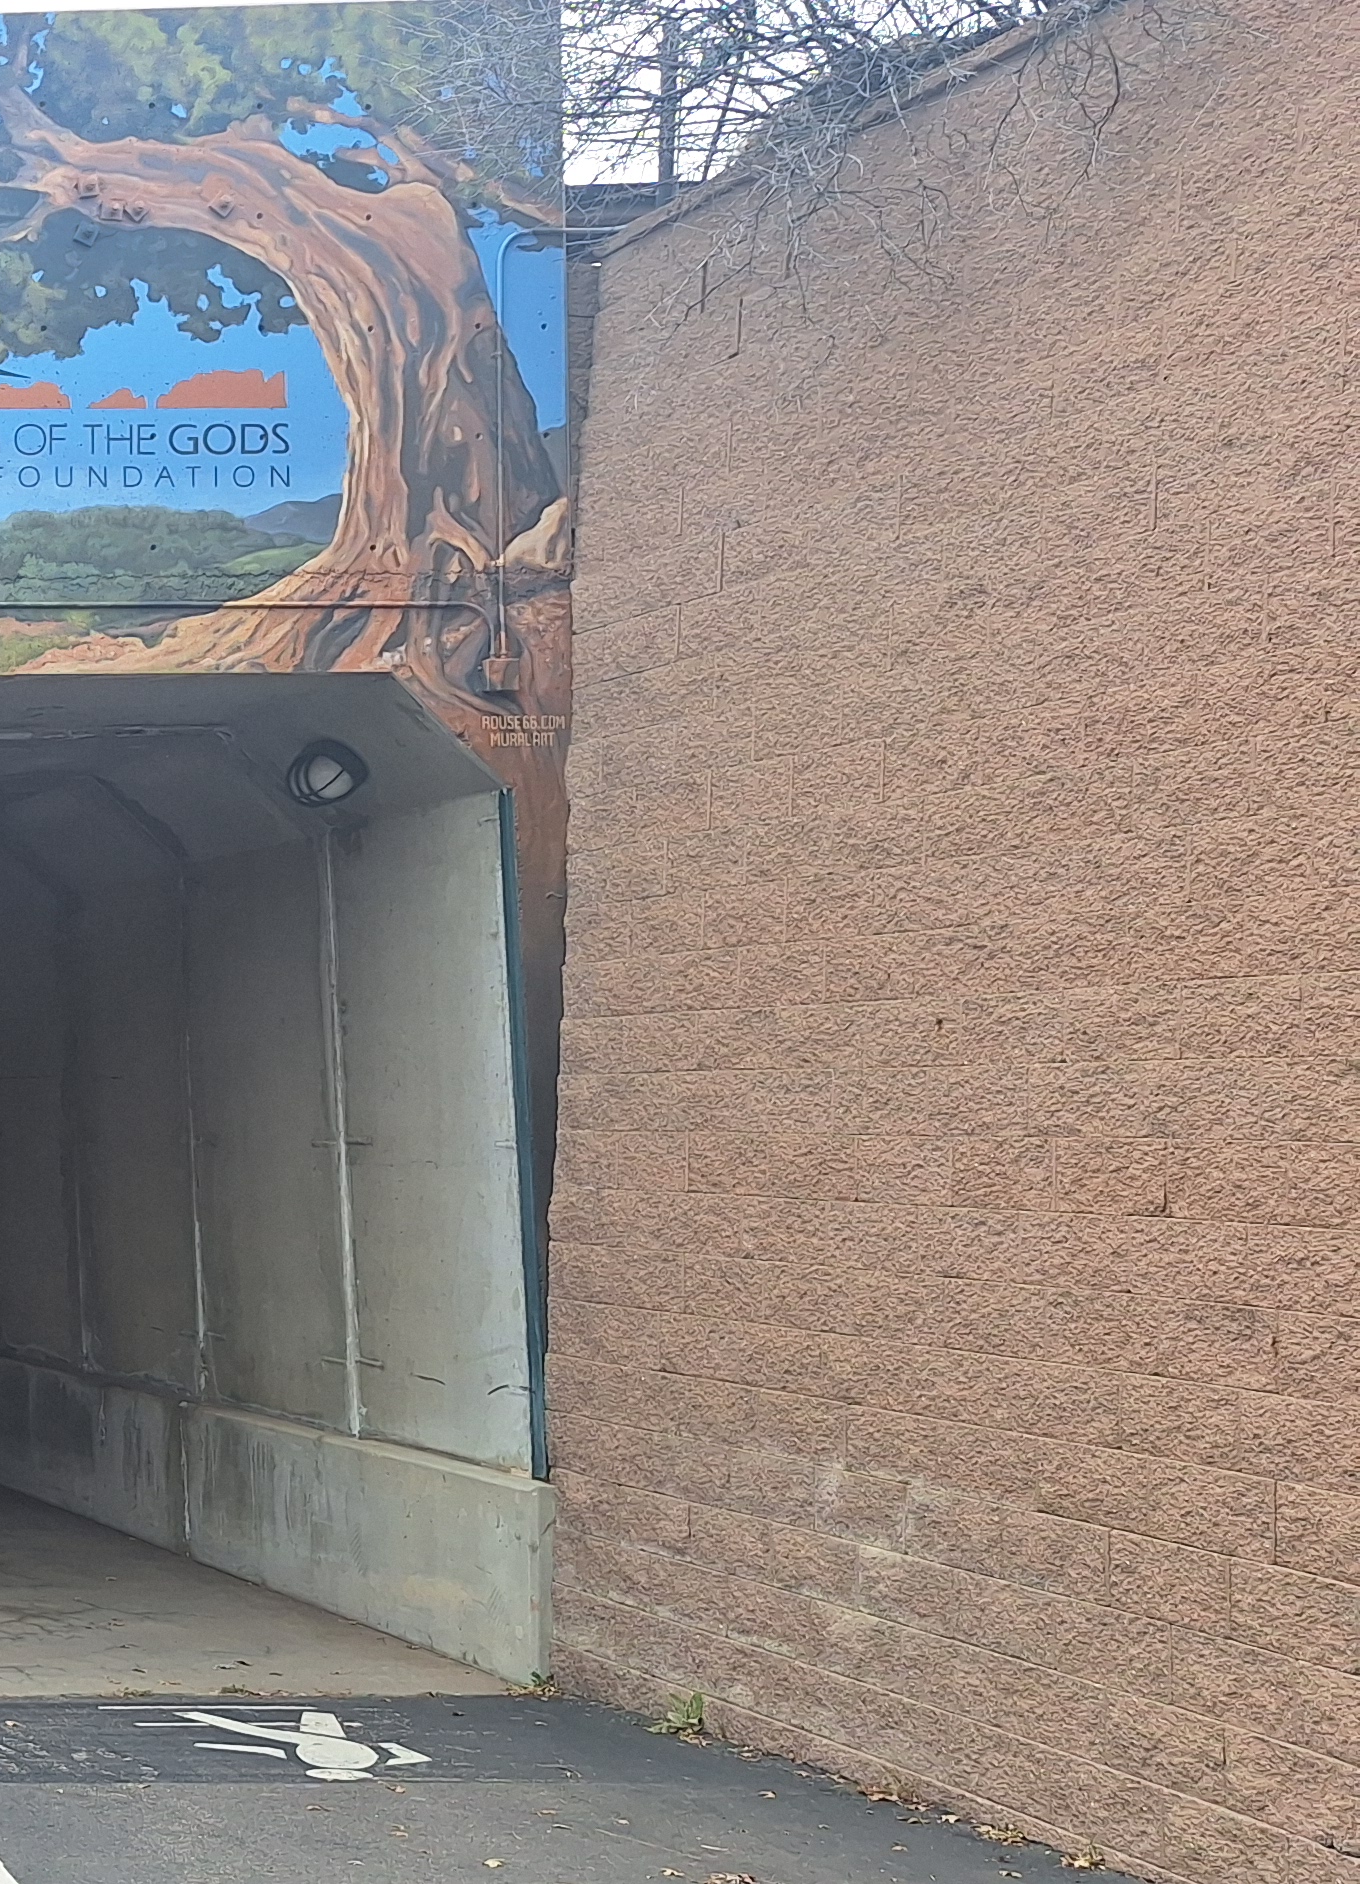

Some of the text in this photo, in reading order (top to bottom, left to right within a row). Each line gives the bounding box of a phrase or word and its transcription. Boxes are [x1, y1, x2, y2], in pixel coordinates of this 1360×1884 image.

[13, 423, 68, 456] OF
[83, 423, 157, 455] THE
[169, 422, 291, 456] GODS
